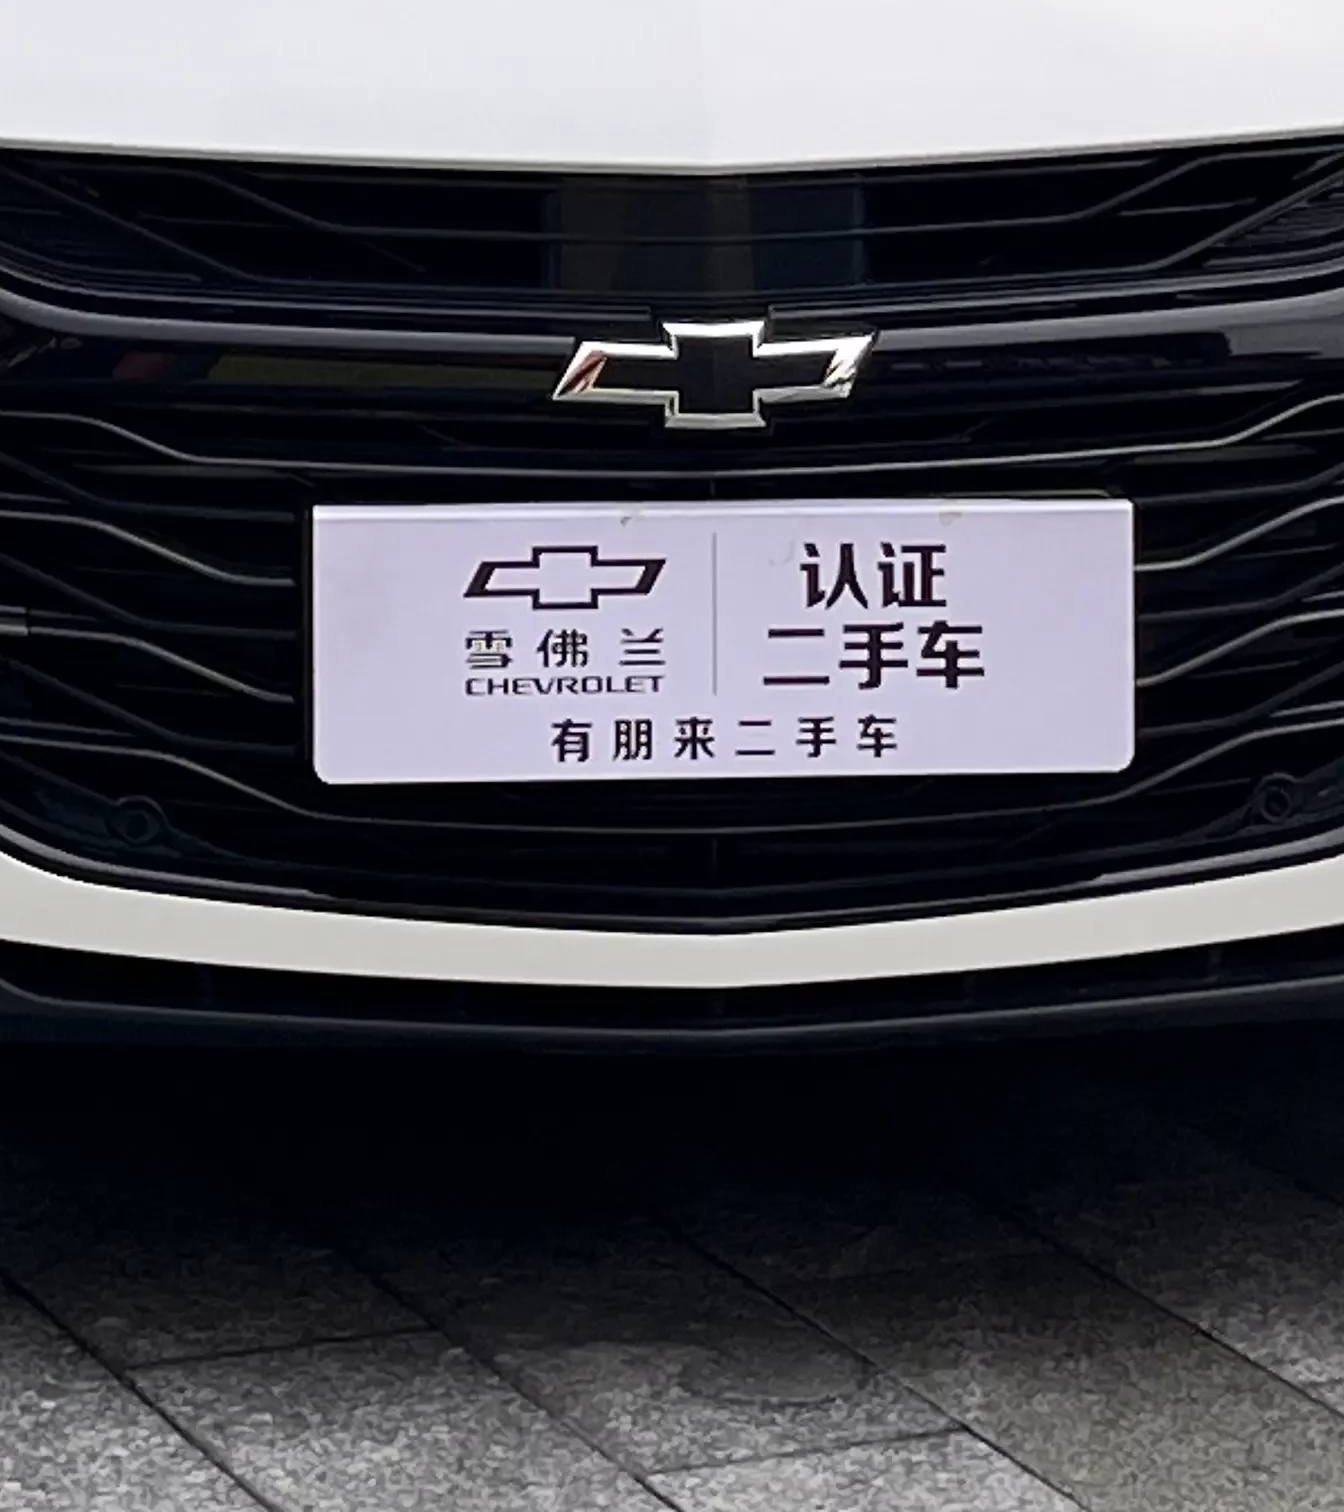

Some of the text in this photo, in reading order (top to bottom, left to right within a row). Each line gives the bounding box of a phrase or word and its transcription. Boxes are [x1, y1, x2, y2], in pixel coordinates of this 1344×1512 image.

[799, 542, 948, 610] 认证
[464, 628, 666, 669] 雪佛兰
[762, 619, 986, 691] 二手车
[464, 675, 666, 696] CHEVROLET
[551, 715, 898, 763] 有朋来二手车
